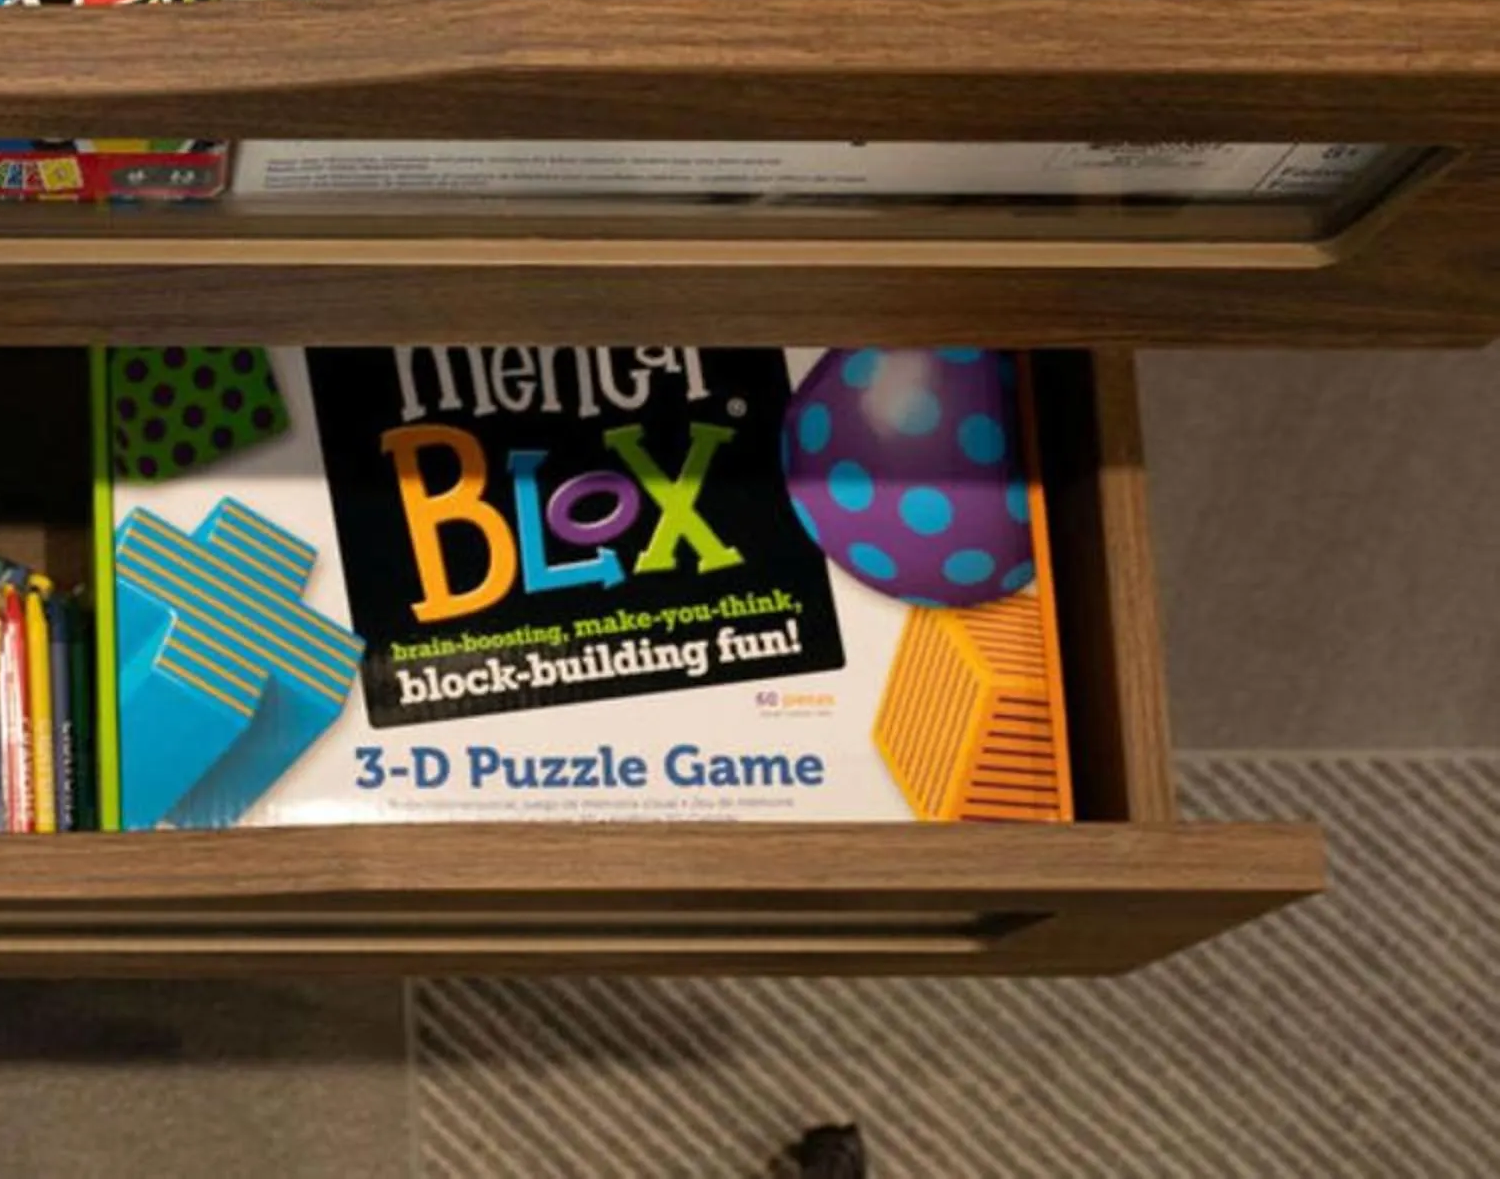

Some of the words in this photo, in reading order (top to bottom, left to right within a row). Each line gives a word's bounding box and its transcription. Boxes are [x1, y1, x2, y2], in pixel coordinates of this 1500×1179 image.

[380, 423, 746, 624] BLOX
[390, 623, 571, 662] brain-boosting,
[574, 589, 803, 640] make-you-think,
[397, 638, 710, 705] block-building
[715, 619, 803, 663] fun!
[355, 747, 451, 789] 3-D
[466, 745, 649, 789] Puzzle
[664, 744, 825, 788] Game
